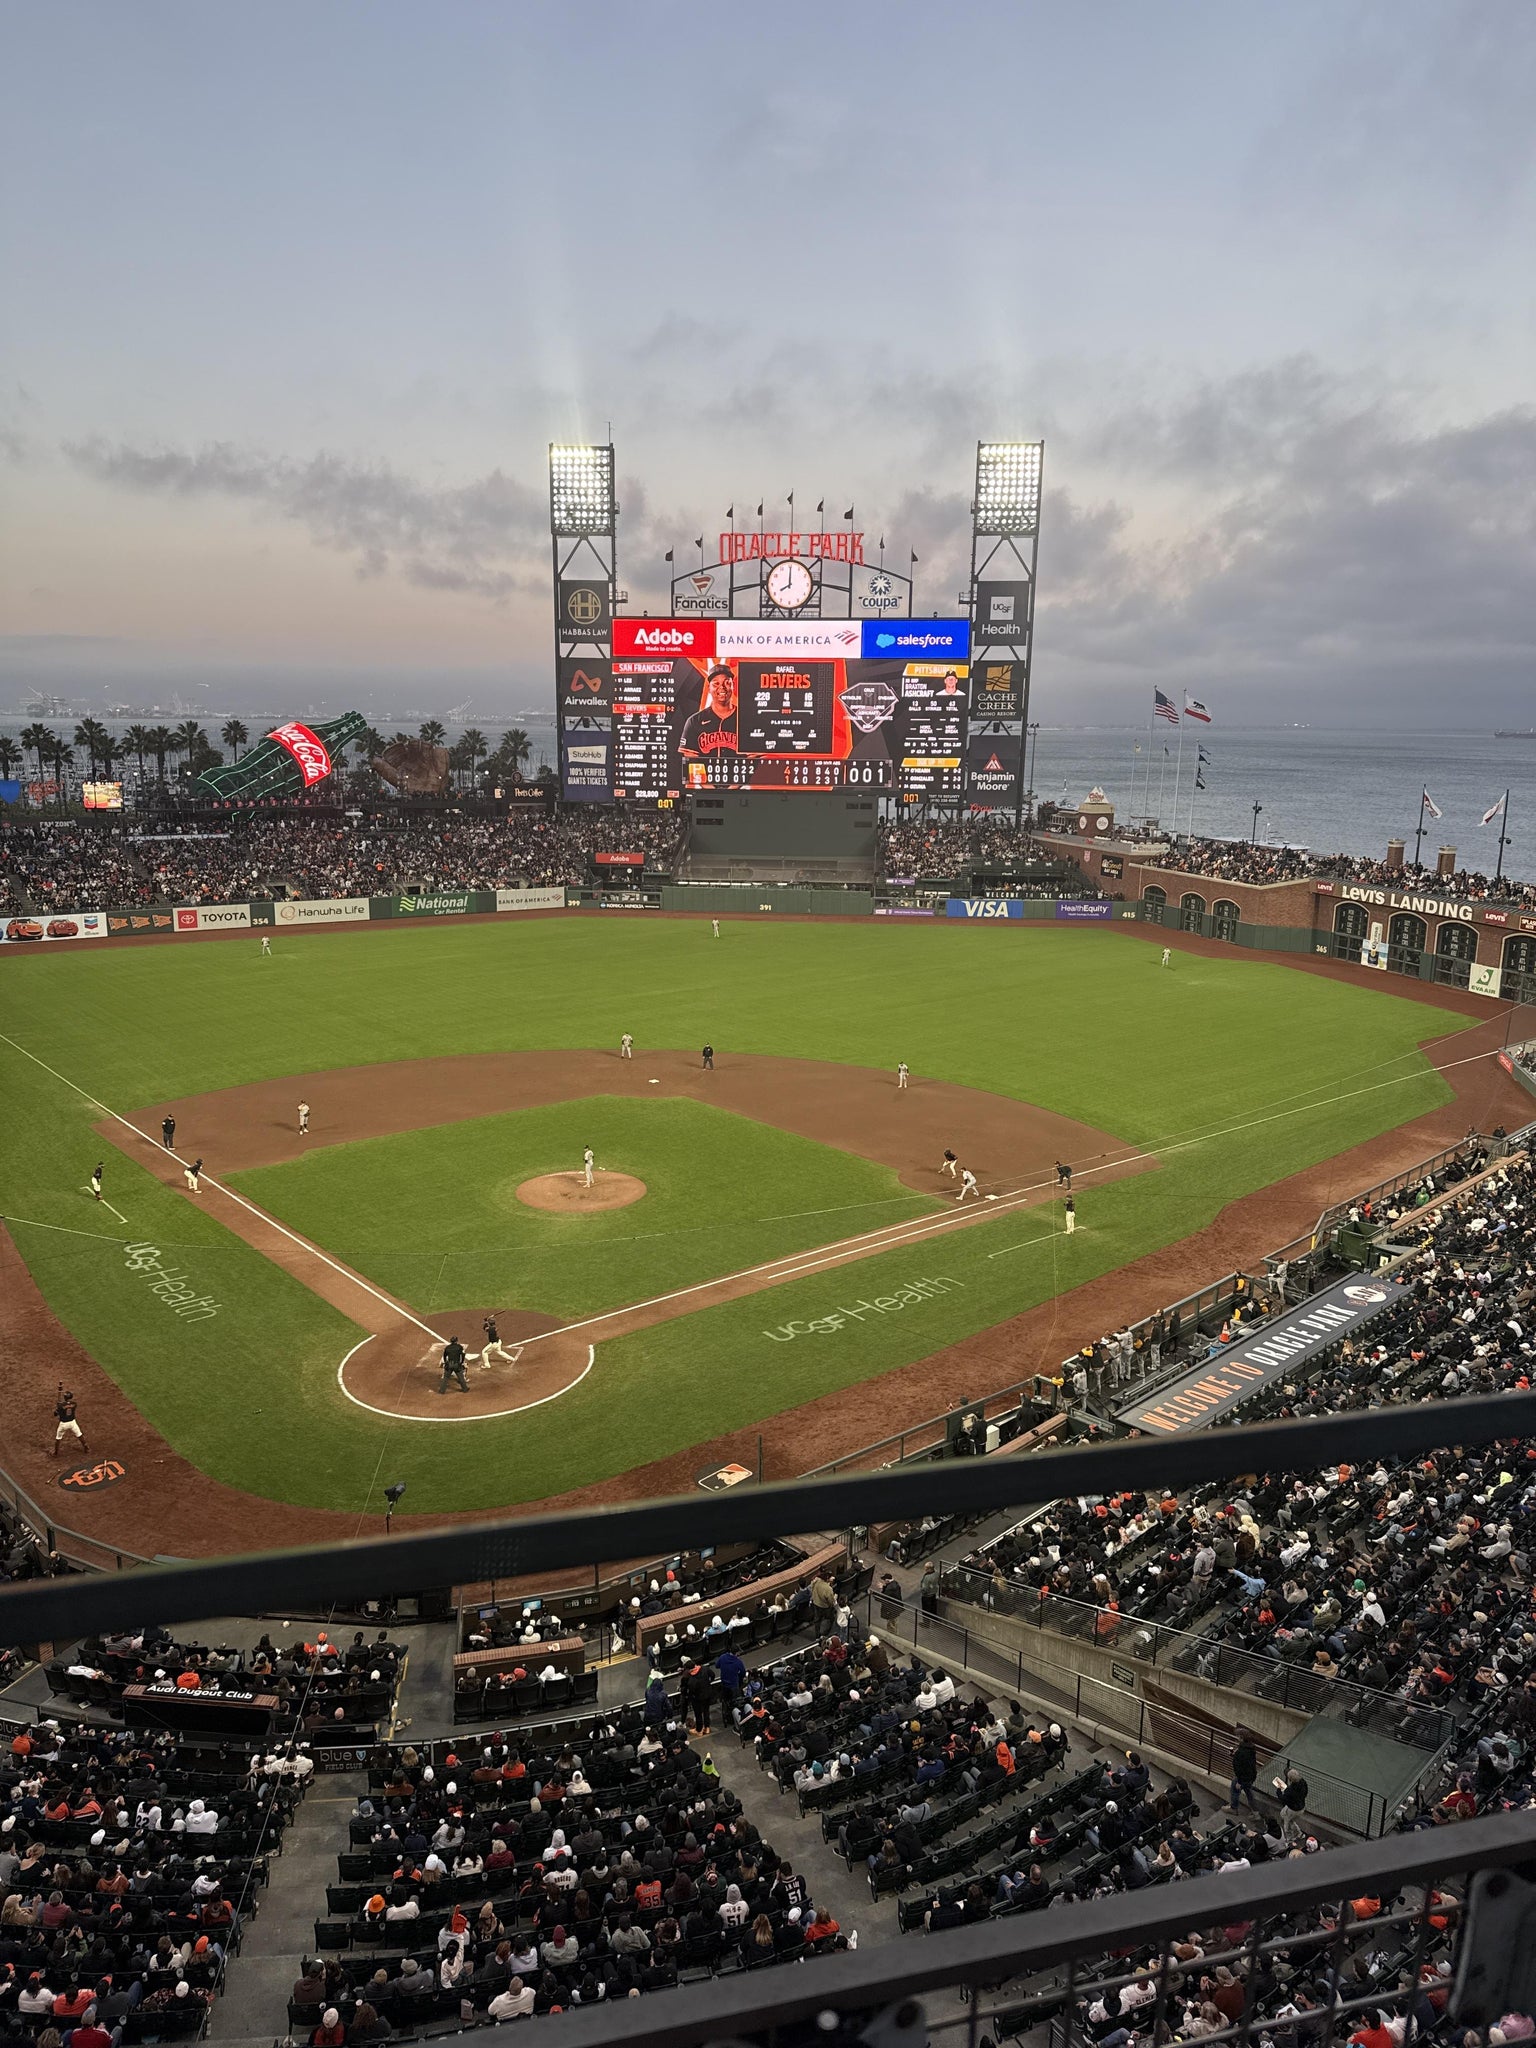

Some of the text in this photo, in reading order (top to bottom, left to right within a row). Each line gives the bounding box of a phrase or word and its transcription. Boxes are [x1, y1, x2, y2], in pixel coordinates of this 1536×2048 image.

[719, 533, 864, 565] ORACLE PARK
[675, 595, 728, 609] Fanatics
[862, 598, 898, 610] coupa
[992, 604, 1011, 613] UCSF
[982, 624, 1020, 634] Health
[634, 628, 694, 645] Adobe
[720, 636, 830, 644] BANK OF AMERICA
[897, 634, 953, 648] salesforce
[619, 663, 670, 672] SAN FRANCISCO
[760, 674, 811, 688] DEVERS
[565, 696, 607, 706] Airwallex
[784, 692, 790, 700] 4
[978, 693, 1017, 701] CACHE
[978, 702, 1015, 710] CREEK
[570, 768, 606, 777] 100% VERIFIED
[971, 772, 1014, 784] Benjamin
[568, 777, 607, 785] GIANTS TICKETS
[977, 782, 1008, 791] Moore
[528, 788, 544, 797] Coffee
[658, 799, 673, 808] 0:07
[970, 803, 992, 812] Coors
[416, 896, 468, 910] National
[1390, 894, 1473, 920] LANDING
[298, 906, 364, 917] Hanwha Life
[961, 901, 1009, 917] VISA
[1061, 905, 1108, 915] HealthEquity
[201, 912, 247, 922] TOYOTA
[1316, 944, 1327, 953] 365
[124, 1242, 222, 1323] UCSF Health
[762, 1277, 965, 1341] UCSF Health
[1139, 1303, 1358, 1431] WELCOME TO ORACLE PARK
[178, 1688, 223, 1697] Dugout
[225, 1691, 253, 1699] Club
[320, 1750, 352, 1762] blue
[136, 1815, 150, 1828] 22
[644, 1895, 660, 1908] 35
[788, 1889, 801, 1904] 51
[726, 1915, 740, 1927] 51
